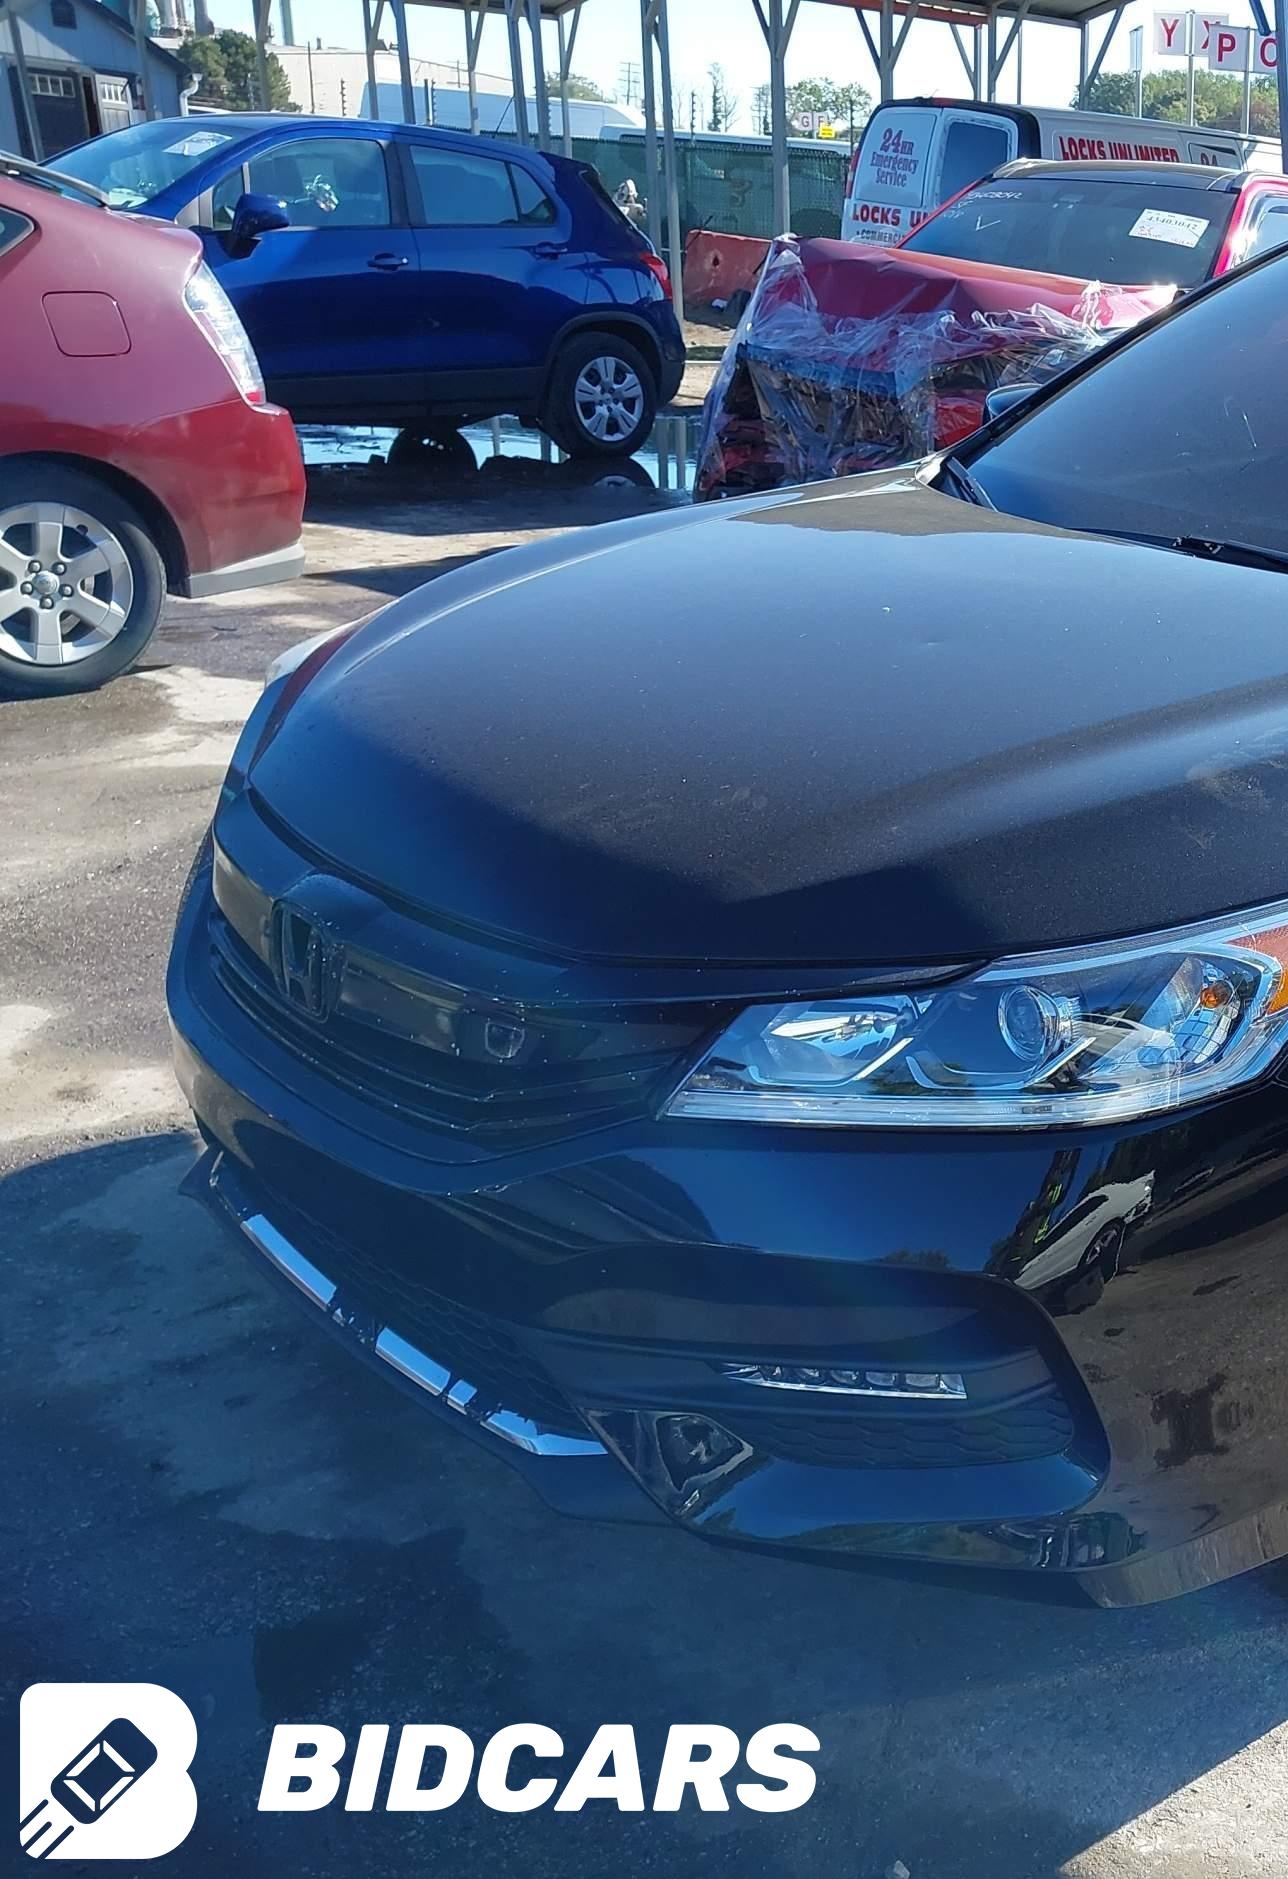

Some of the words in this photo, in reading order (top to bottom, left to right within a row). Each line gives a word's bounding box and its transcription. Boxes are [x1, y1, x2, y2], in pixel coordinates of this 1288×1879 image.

[1161, 18, 1179, 47] Y
[1217, 33, 1236, 62] P
[1059, 136, 1107, 160] LOCKS
[870, 151, 919, 175] Emergency
[875, 168, 908, 188] Service
[852, 203, 902, 226] LOCKS
